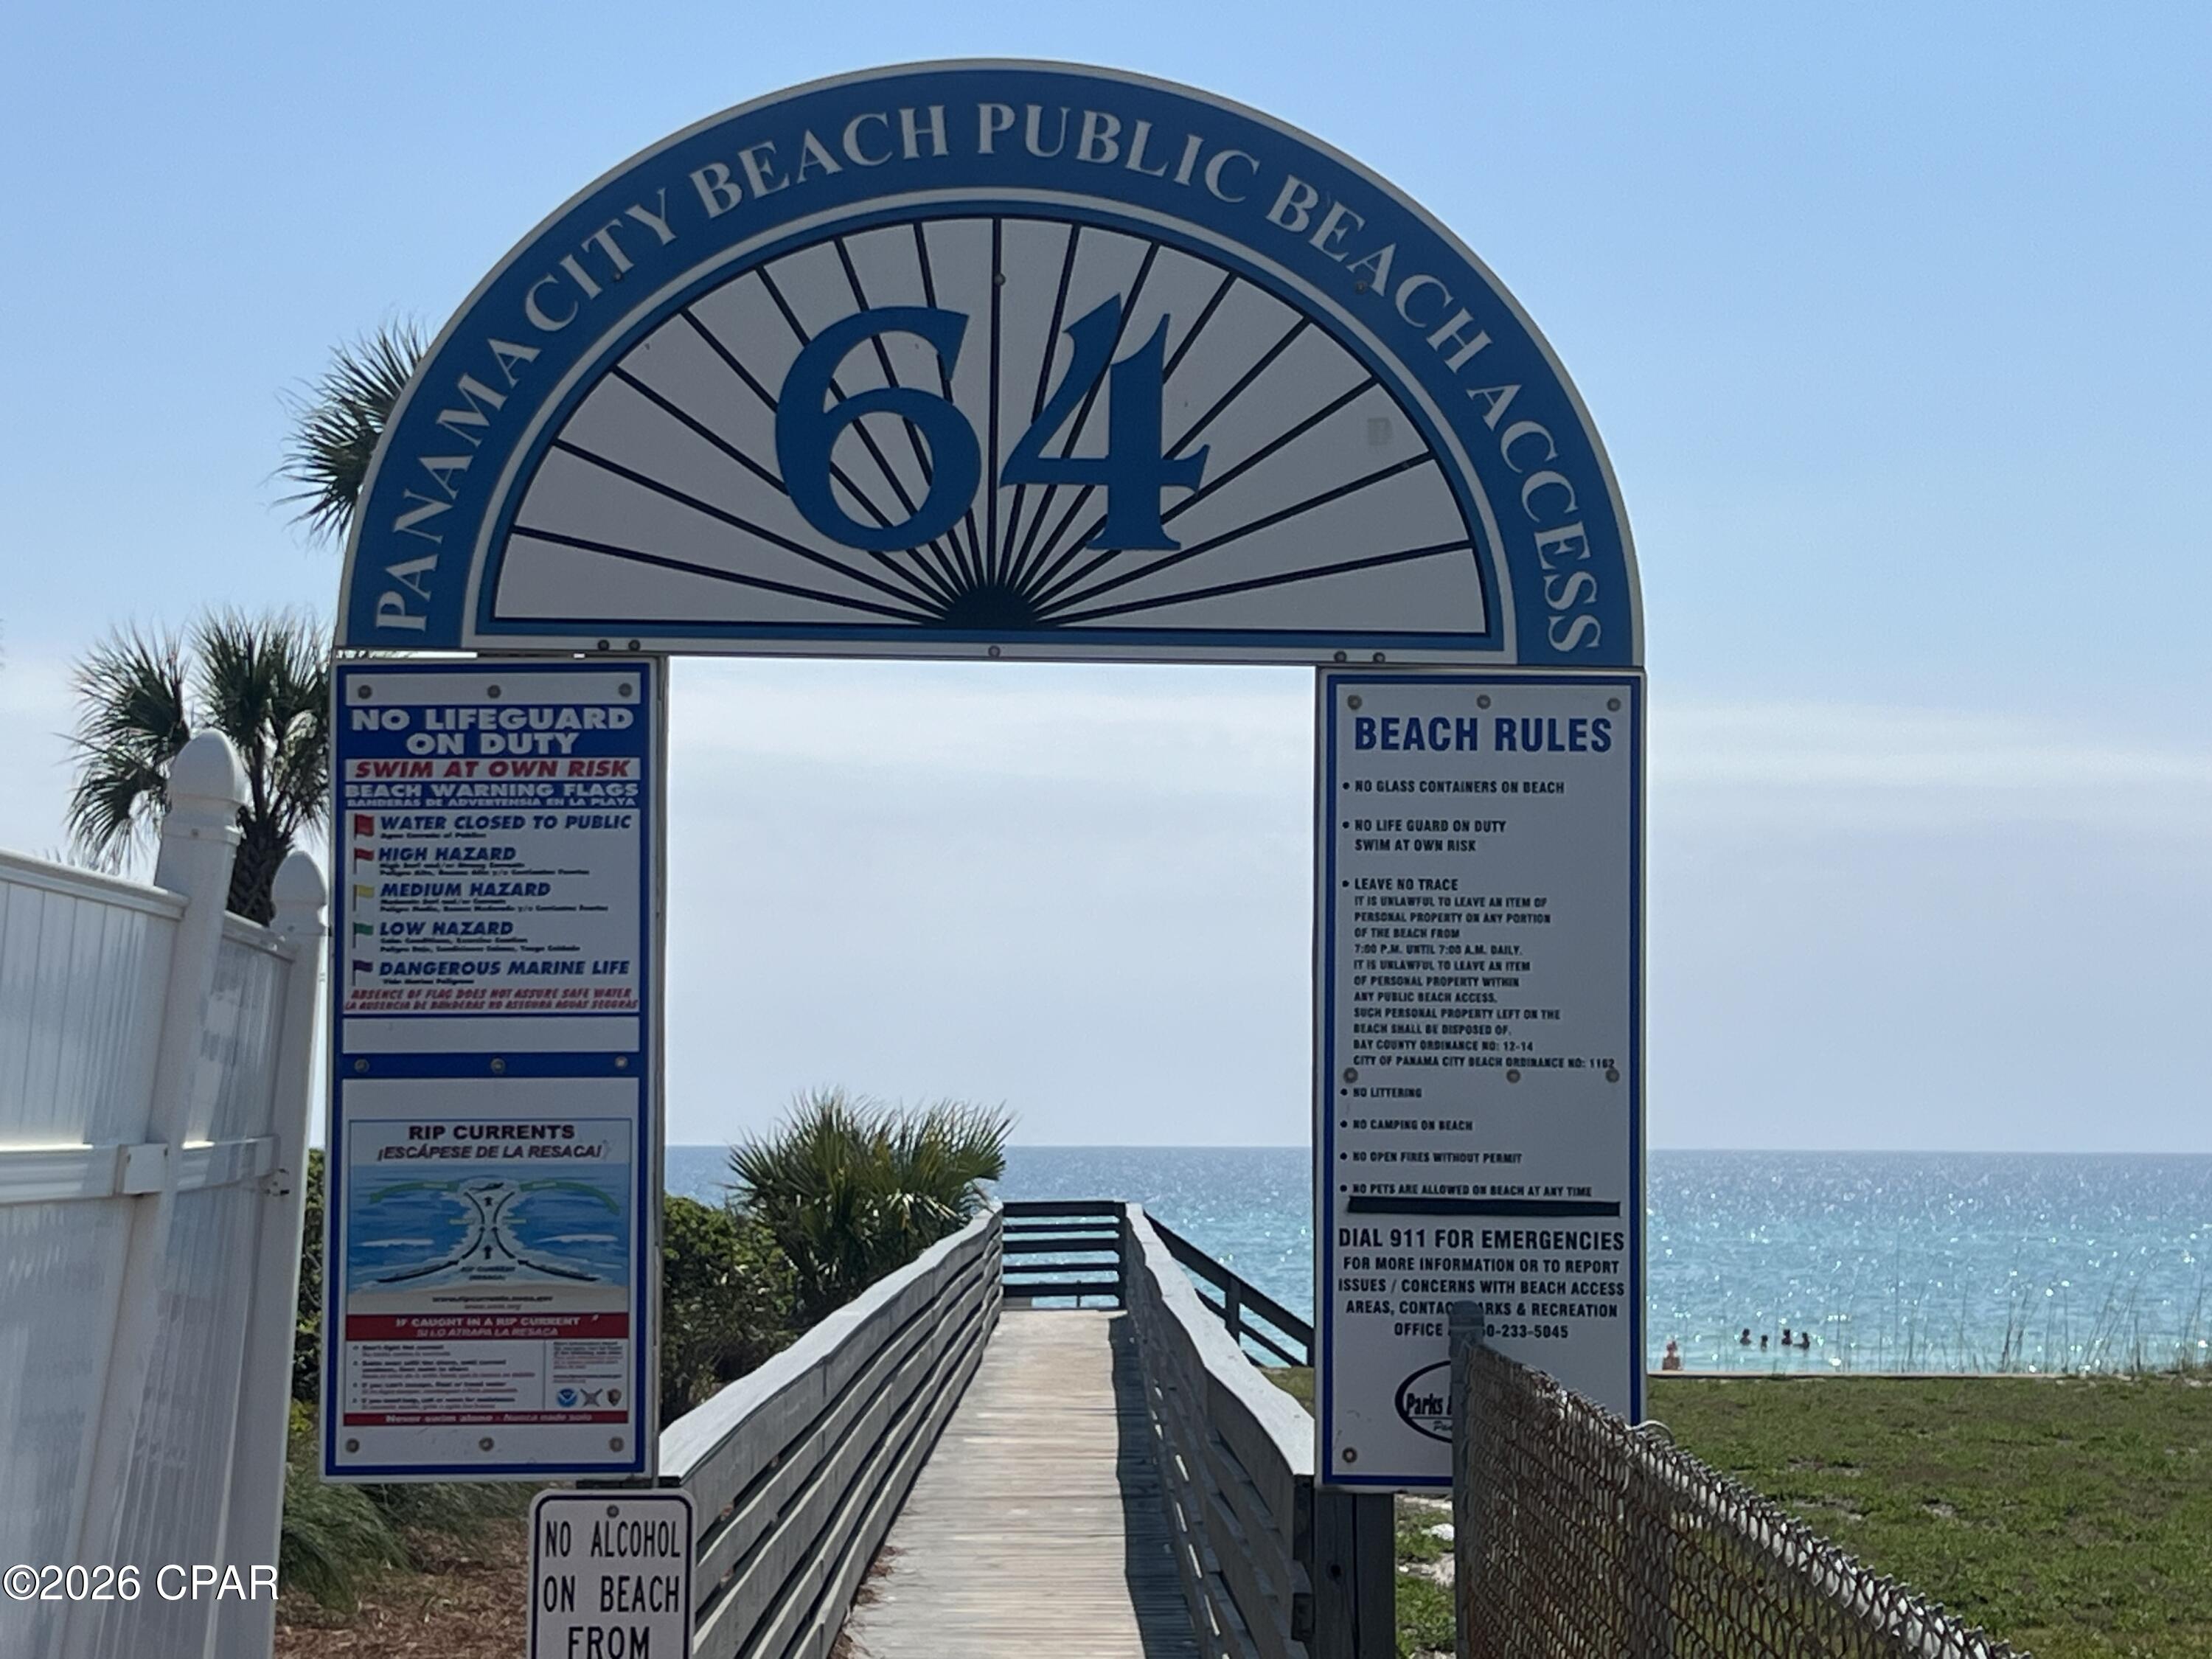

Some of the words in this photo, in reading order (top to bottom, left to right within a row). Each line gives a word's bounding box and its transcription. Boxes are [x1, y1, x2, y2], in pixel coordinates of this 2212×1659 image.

[376, 337, 541, 632] PANAMA
[524, 188, 678, 331] CITY
[691, 105, 948, 218] BEACH
[976, 102, 1261, 203] PUBLIC
[1266, 174, 1493, 373] BEACH
[1467, 383, 1601, 653] ACCESS
[776, 293, 1210, 552] 64
[352, 709, 409, 730] NO
[425, 709, 634, 729] LIFEGUARD
[1354, 717, 1477, 751] BEACH
[1495, 717, 1613, 752] RULES
[406, 734, 463, 754] ON
[480, 733, 579, 754] DUTY
[355, 761, 435, 778] SWIM
[442, 761, 479, 778] AT
[487, 760, 558, 777] OWN
[566, 760, 630, 777] RISK
[346, 785, 421, 797] BEACH
[431, 784, 553, 797] WARNING
[563, 784, 639, 796] FLAGS
[1354, 780, 1371, 793] NO
[1377, 780, 1414, 793] GLASS
[1419, 781, 1496, 793] CONTAINERS
[1501, 781, 1517, 793] ON
[1523, 781, 1565, 794] BEACH
[380, 816, 447, 830] WATER
[453, 815, 526, 830] CLOSED
[530, 815, 558, 829] TO
[564, 815, 632, 829] PUBLIC
[1354, 820, 1371, 832] NO
[1376, 820, 1401, 832] LIFE
[1406, 820, 1447, 832] GUARD
[1453, 821, 1470, 832] ON
[1475, 821, 1506, 832] DUTY
[378, 847, 428, 860] HIGH
[434, 847, 516, 860] HAZARD
[1354, 840, 1389, 852] SWIM
[1394, 840, 1409, 852] AT
[1414, 840, 1442, 852] OWN
[1447, 840, 1476, 852] RISK
[380, 883, 463, 897] MEDIUM
[468, 883, 551, 896] HAZARD
[1354, 879, 1391, 890] LEAVE
[1397, 879, 1413, 891] NO
[1418, 879, 1458, 891] TRACE
[1354, 897, 1363, 907] IT
[1367, 897, 1377, 907] IS
[1380, 897, 1434, 907] UNLAWFUL
[1438, 897, 1450, 907] TO
[1454, 897, 1484, 908] LEAVE
[1489, 897, 1501, 908] AN
[1506, 897, 1530, 908] ITEM
[1534, 897, 1548, 908] OF
[380, 922, 425, 935] LOW
[431, 922, 513, 935] HAZARD
[380, 961, 501, 975] DANGEROUS
[507, 961, 585, 975] MARINE
[591, 961, 630, 974] LIFE
[1354, 992, 1374, 1002] ANY
[1377, 992, 1413, 1003] PUBLIC
[1418, 992, 1451, 1003] BEACH
[1353, 1040, 1373, 1051] BAY
[1376, 1040, 1416, 1051] COUNTY
[1420, 1040, 1478, 1051] ORDINANCE
[1503, 1041, 1533, 1051] 12-14
[1353, 1056, 1375, 1066] CITY
[1379, 1056, 1391, 1066] OF
[1396, 1056, 1439, 1067] PANAMA
[1442, 1057, 1464, 1067] CITY
[1468, 1057, 1502, 1067] BEACH
[1506, 1057, 1563, 1068] ORDINANCE
[1353, 1088, 1366, 1097] NO
[1371, 1088, 1422, 1098] LITTERING
[409, 1126, 445, 1140] RIP
[453, 1125, 574, 1139] CURRENTS
[1353, 1120, 1366, 1130] NO
[1370, 1120, 1417, 1130] CAMPING
[1421, 1120, 1434, 1130] ON
[1439, 1121, 1473, 1131] BEACH
[474, 1144, 499, 1160] DE
[501, 1144, 525, 1159] LA
[526, 1144, 602, 1159] RESACA!
[1353, 1152, 1366, 1161] NO
[1370, 1152, 1397, 1162] OPEN
[1400, 1152, 1429, 1162] FIRES
[1433, 1152, 1479, 1163] WITHOUT
[1483, 1153, 1523, 1164] PERMIT
[1353, 1183, 1366, 1194] NO
[1370, 1184, 1394, 1194] PETS
[1398, 1184, 1417, 1194] ARE
[1421, 1184, 1469, 1195] ALLOWED
[1472, 1185, 1486, 1195] ON
[1490, 1186, 1523, 1196] BEACH
[1528, 1186, 1540, 1196] AT
[1543, 1186, 1562, 1197] ANY
[1566, 1186, 1593, 1197] TIME
[1339, 1228, 1382, 1247] DIAL
[1390, 1229, 1424, 1248] 911
[1435, 1229, 1472, 1248] FOR
[1482, 1230, 1624, 1251] EMERGENCIES
[1343, 1257, 1369, 1270] FOR
[1375, 1257, 1413, 1270] MORE
[1419, 1258, 1514, 1272] INFORMATION
[1520, 1259, 1537, 1273] OR
[1543, 1259, 1559, 1273] TO
[1565, 1259, 1620, 1273] REPORT
[1338, 1279, 1385, 1292] ISSUES
[1391, 1279, 1396, 1292] /
[1402, 1279, 1475, 1293] CONCERNS
[1480, 1281, 1514, 1294] WITH
[1520, 1281, 1565, 1295] BEACH
[1571, 1281, 1625, 1295] ACCESS
[1346, 1300, 1394, 1315] AREAS,
[1399, 1301, 1453, 1315] CONTAC
[1517, 1303, 1525, 1315] &
[1531, 1303, 1618, 1316] RECREATION
[1394, 1323, 1443, 1336] OFFICE
[1482, 1324, 1568, 1338] 0-233-5045
[1406, 1393, 1443, 1415] Parks
[546, 1520, 570, 1557] NO
[591, 1520, 680, 1557] ALCOHOL
[543, 1576, 574, 1613] ON
[600, 1576, 679, 1613] BEACH
[568, 1627, 650, 1659] FROM
